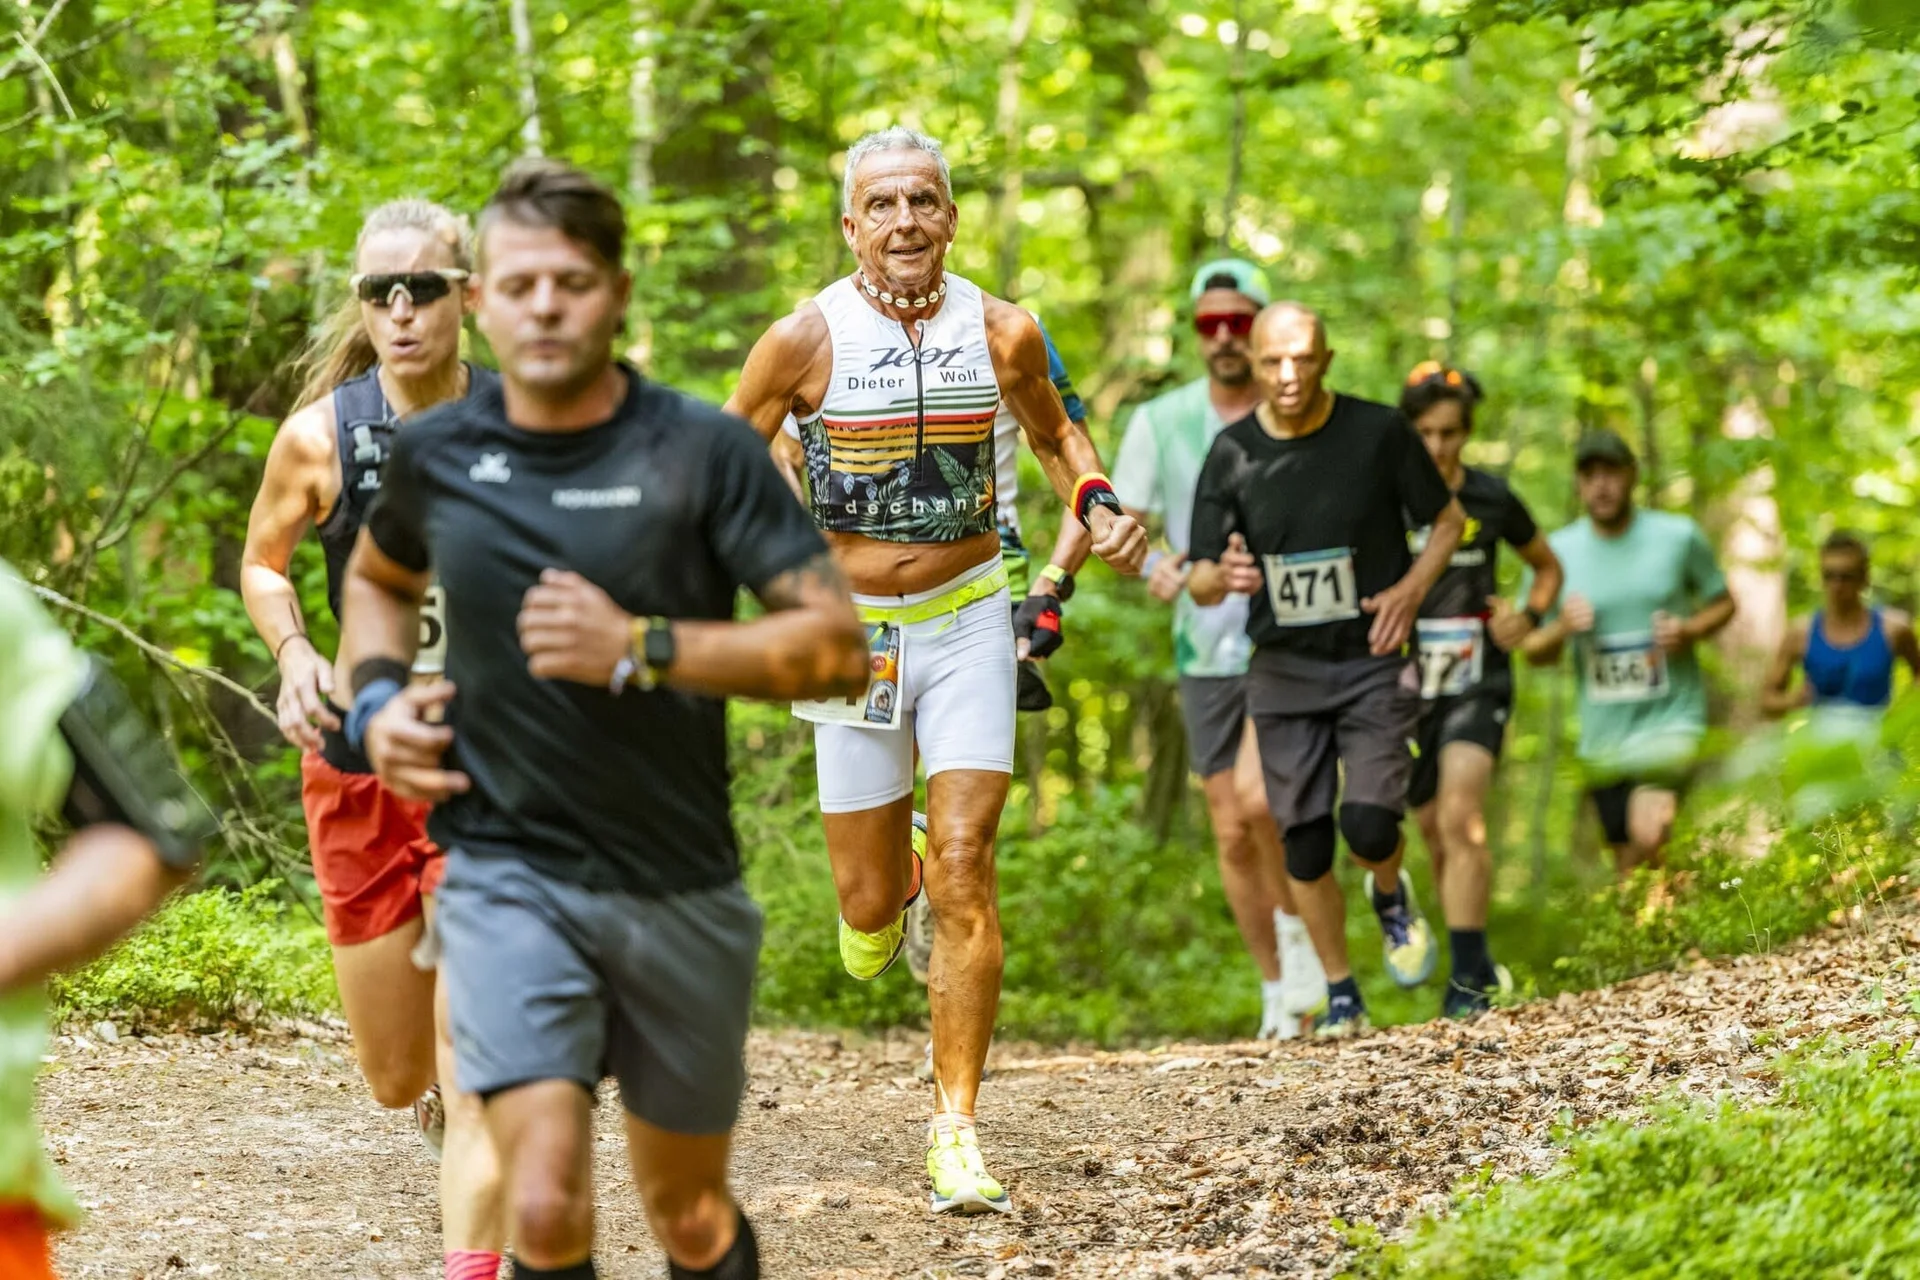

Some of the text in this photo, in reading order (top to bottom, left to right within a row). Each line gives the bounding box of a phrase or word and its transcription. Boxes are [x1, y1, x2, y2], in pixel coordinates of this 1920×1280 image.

[848, 369, 978, 390] Dieter Wolf
[1280, 565, 1343, 608] 471
